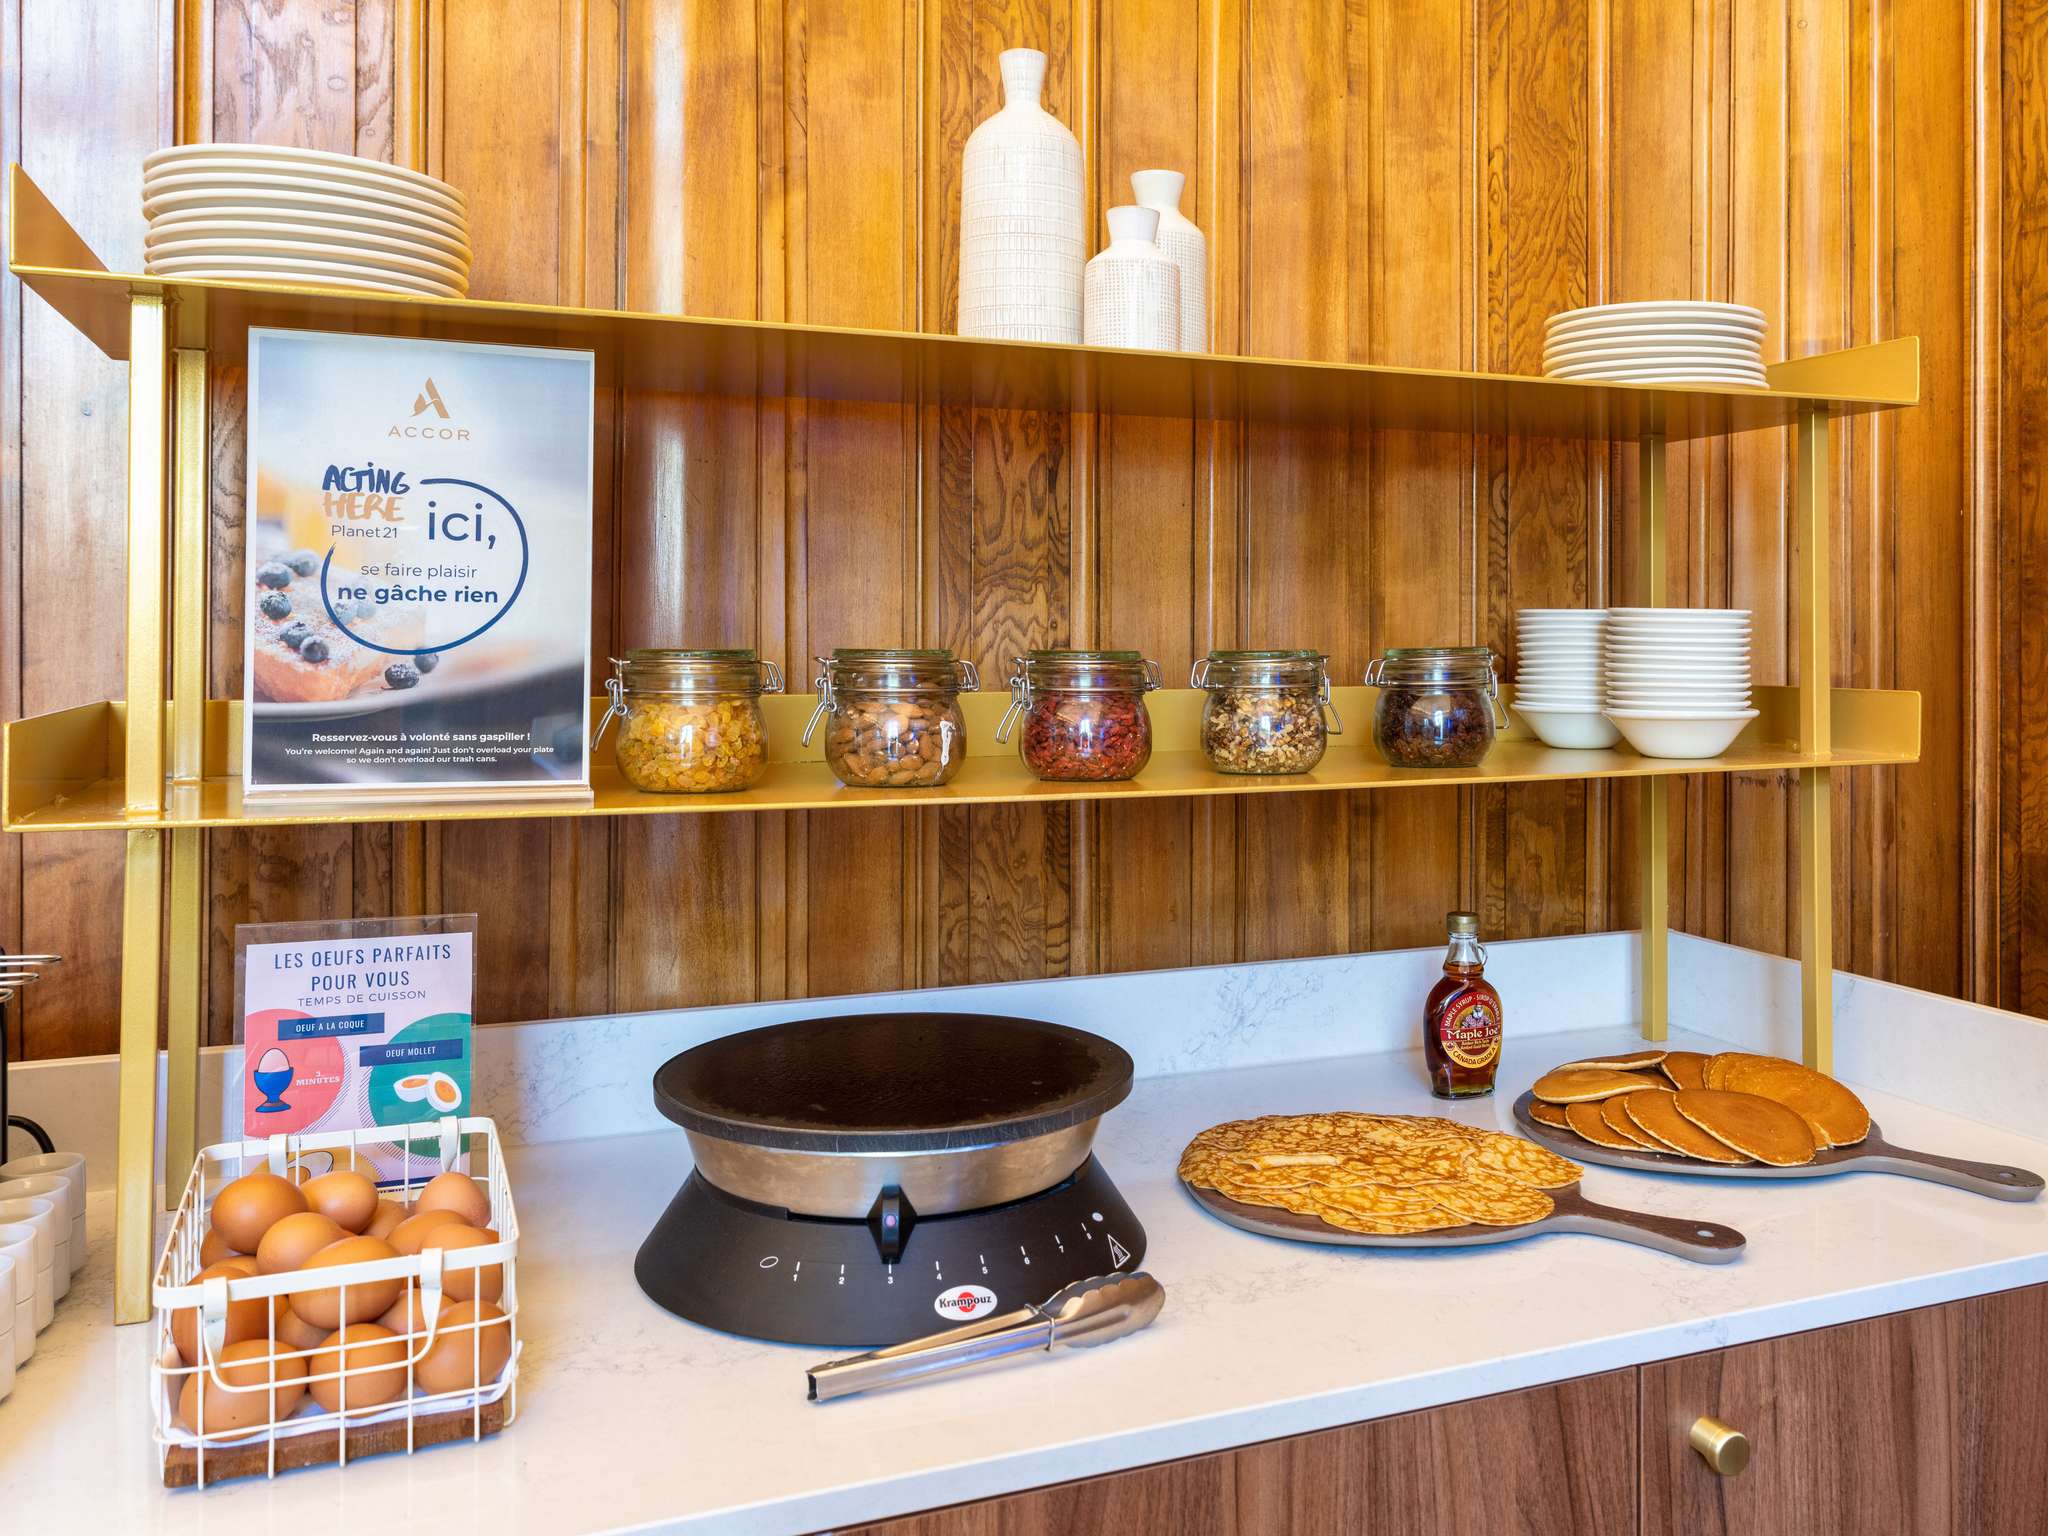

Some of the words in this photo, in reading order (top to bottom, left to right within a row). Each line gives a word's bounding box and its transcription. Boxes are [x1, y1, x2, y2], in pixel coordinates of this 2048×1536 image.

[388, 425, 471, 440] ACCOR
[322, 491, 404, 522] HERE
[427, 501, 496, 549] ici,
[360, 565, 379, 576] se
[384, 563, 422, 577] faire
[427, 565, 477, 580] plaisir
[337, 586, 367, 601] ne
[375, 583, 448, 604] gâche
[454, 586, 498, 603] rien
[312, 733, 398, 742] Resservez-vous
[400, 732, 407, 741] à
[409, 732, 450, 741] volonté
[479, 732, 525, 742] gaspiller
[314, 747, 357, 755] welcome!
[359, 747, 384, 756] Again
[405, 747, 431, 755] again!
[452, 746, 474, 754] don't
[476, 746, 511, 754] overload
[513, 747, 532, 755] your
[533, 746, 554, 755] plate
[453, 755, 474, 763] trash
[274, 952, 303, 969] LES
[311, 949, 364, 968] OEUFS
[372, 944, 452, 964] PARFAITS
[311, 973, 357, 992] POUR
[365, 970, 410, 988] VOUS
[298, 995, 342, 1007] TEMPS
[346, 993, 364, 1004] DE
[368, 990, 427, 1002] CUISSON
[1444, 1007, 1457, 1026] MAPLE
[1456, 996, 1472, 1009] SYRUP
[295, 1022, 317, 1033] OEUF
[318, 1022, 324, 1031] A
[326, 1021, 336, 1030] LA
[338, 1019, 365, 1030] COQUE
[1446, 1028, 1483, 1040] Maple
[1485, 1027, 1498, 1038] Joe
[385, 1047, 406, 1058] OEUF
[407, 1046, 437, 1057] MOLLET
[1453, 1050, 1477, 1065] CANADA
[296, 1076, 340, 1086] MINUTES
[793, 1273, 798, 1282] 1
[838, 1276, 845, 1285] 2
[887, 1276, 894, 1285] 3
[936, 1272, 942, 1281] 4
[981, 1266, 988, 1275] 5
[1024, 1256, 1030, 1265] 6
[1058, 1245, 1064, 1253] 7
[939, 1294, 992, 1309] Krampouz
